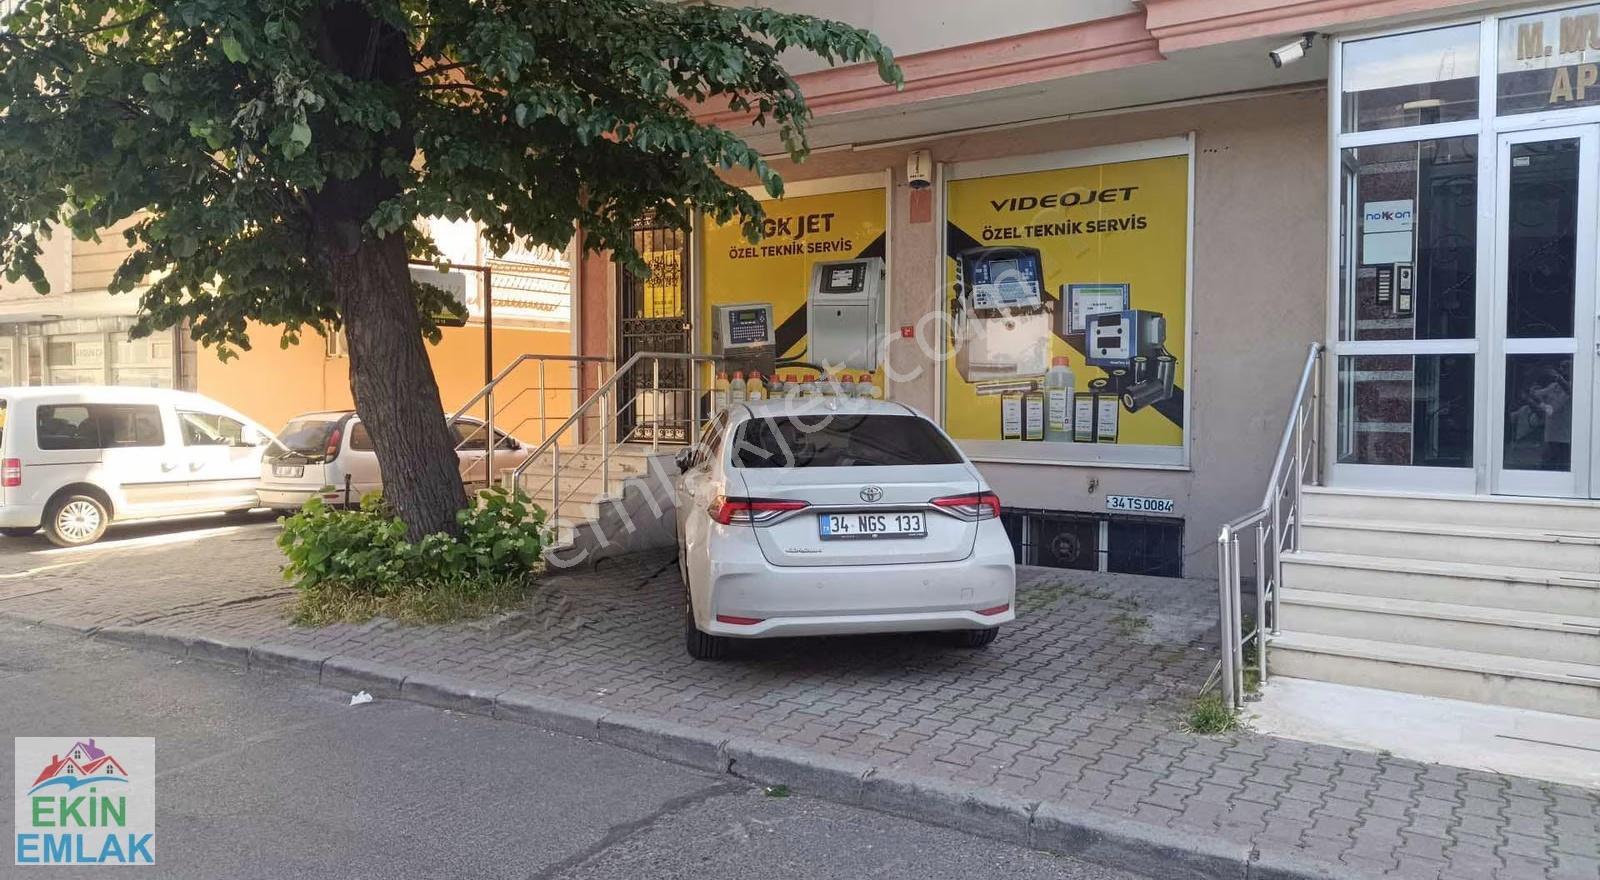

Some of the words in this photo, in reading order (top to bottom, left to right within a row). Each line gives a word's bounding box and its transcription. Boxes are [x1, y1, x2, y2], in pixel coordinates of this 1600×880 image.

[1517, 21, 1552, 60] M.
[990, 186, 1139, 212] VIDEOJET
[793, 213, 835, 240] JET
[982, 225, 1022, 241] ÖZEL
[1024, 219, 1083, 238] TEKNİK
[1086, 214, 1147, 233] SERVİS
[729, 246, 759, 259] ÖZEL
[760, 241, 804, 257] TEKNİK
[807, 237, 853, 253] SERVİS
[1112, 497, 1125, 508] 34
[1127, 498, 1142, 510] TS
[1143, 499, 1171, 511] 0084
[831, 516, 849, 533] 34
[858, 515, 887, 532] NGS
[895, 515, 921, 531] 133
